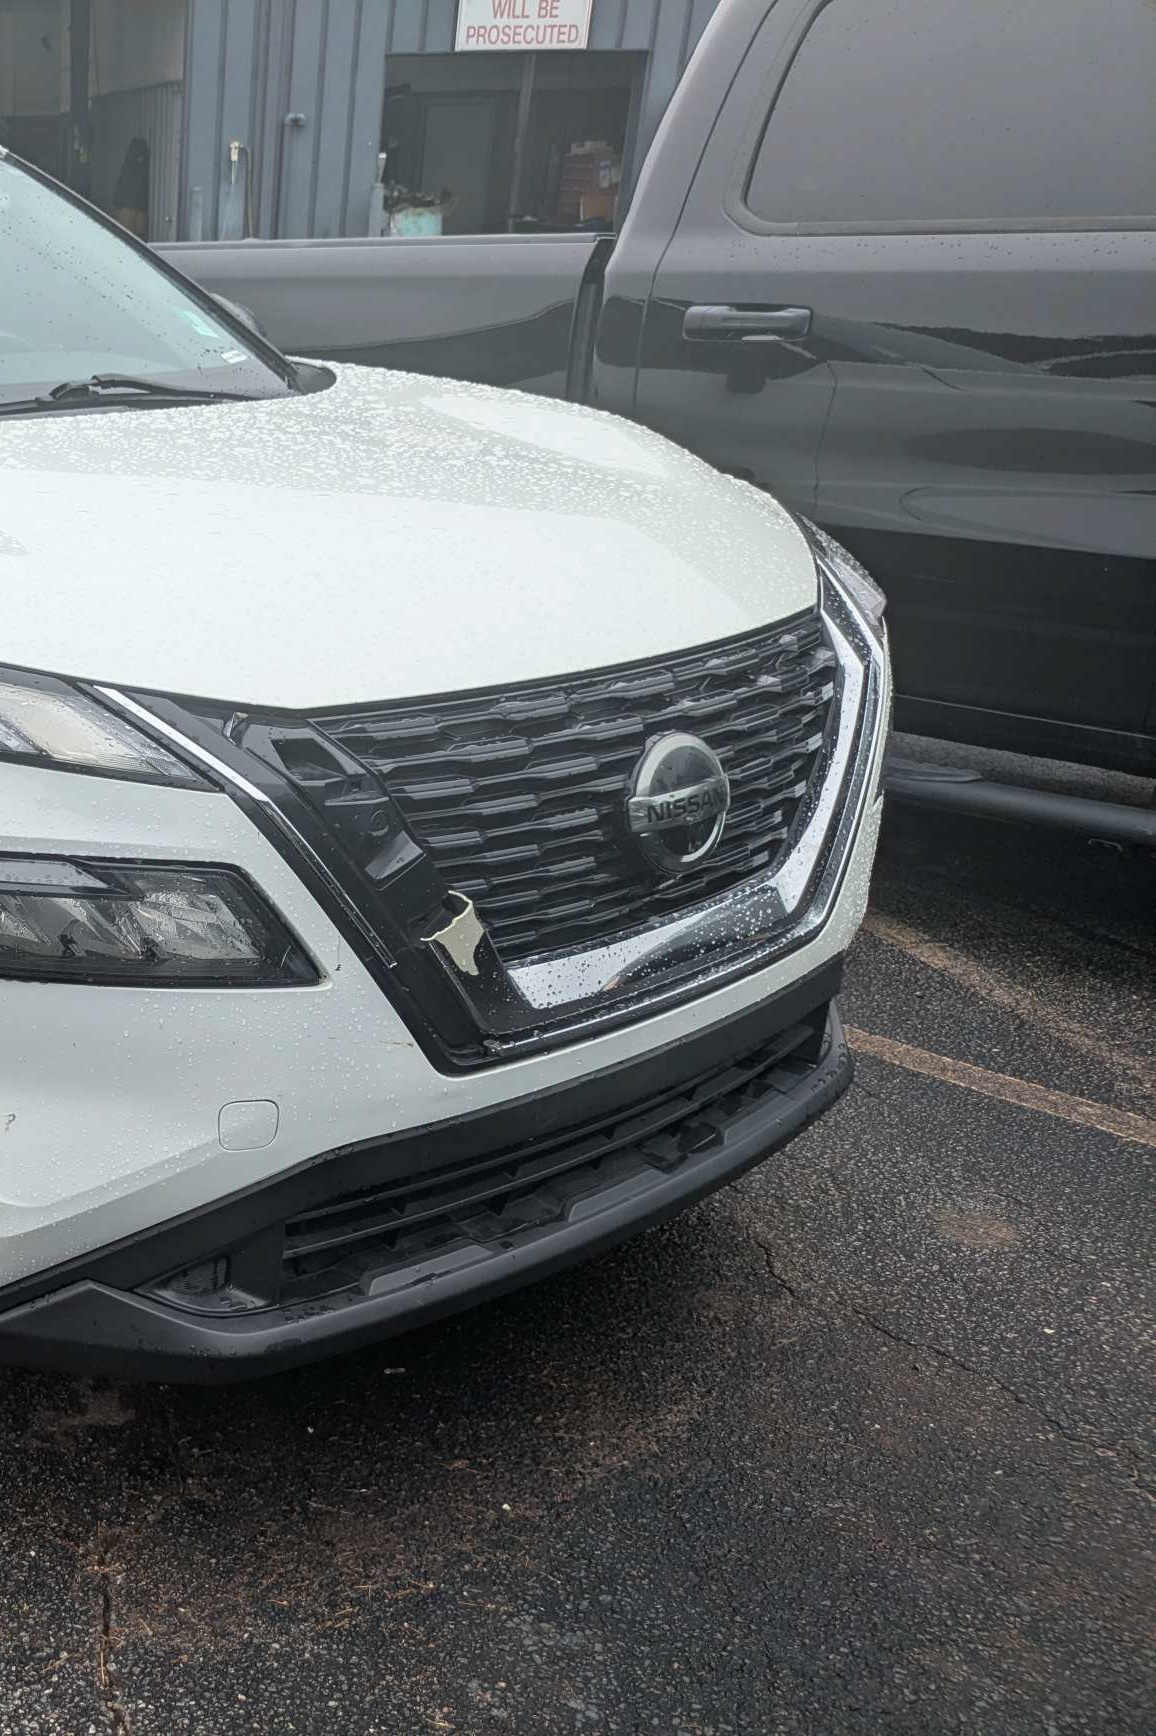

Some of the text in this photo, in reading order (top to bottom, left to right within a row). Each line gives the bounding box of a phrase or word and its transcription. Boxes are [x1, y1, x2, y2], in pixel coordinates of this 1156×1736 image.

[492, 0, 560, 19] WILL BE
[465, 24, 580, 45] PROSECUTED
[647, 787, 726, 823] NISSAN
